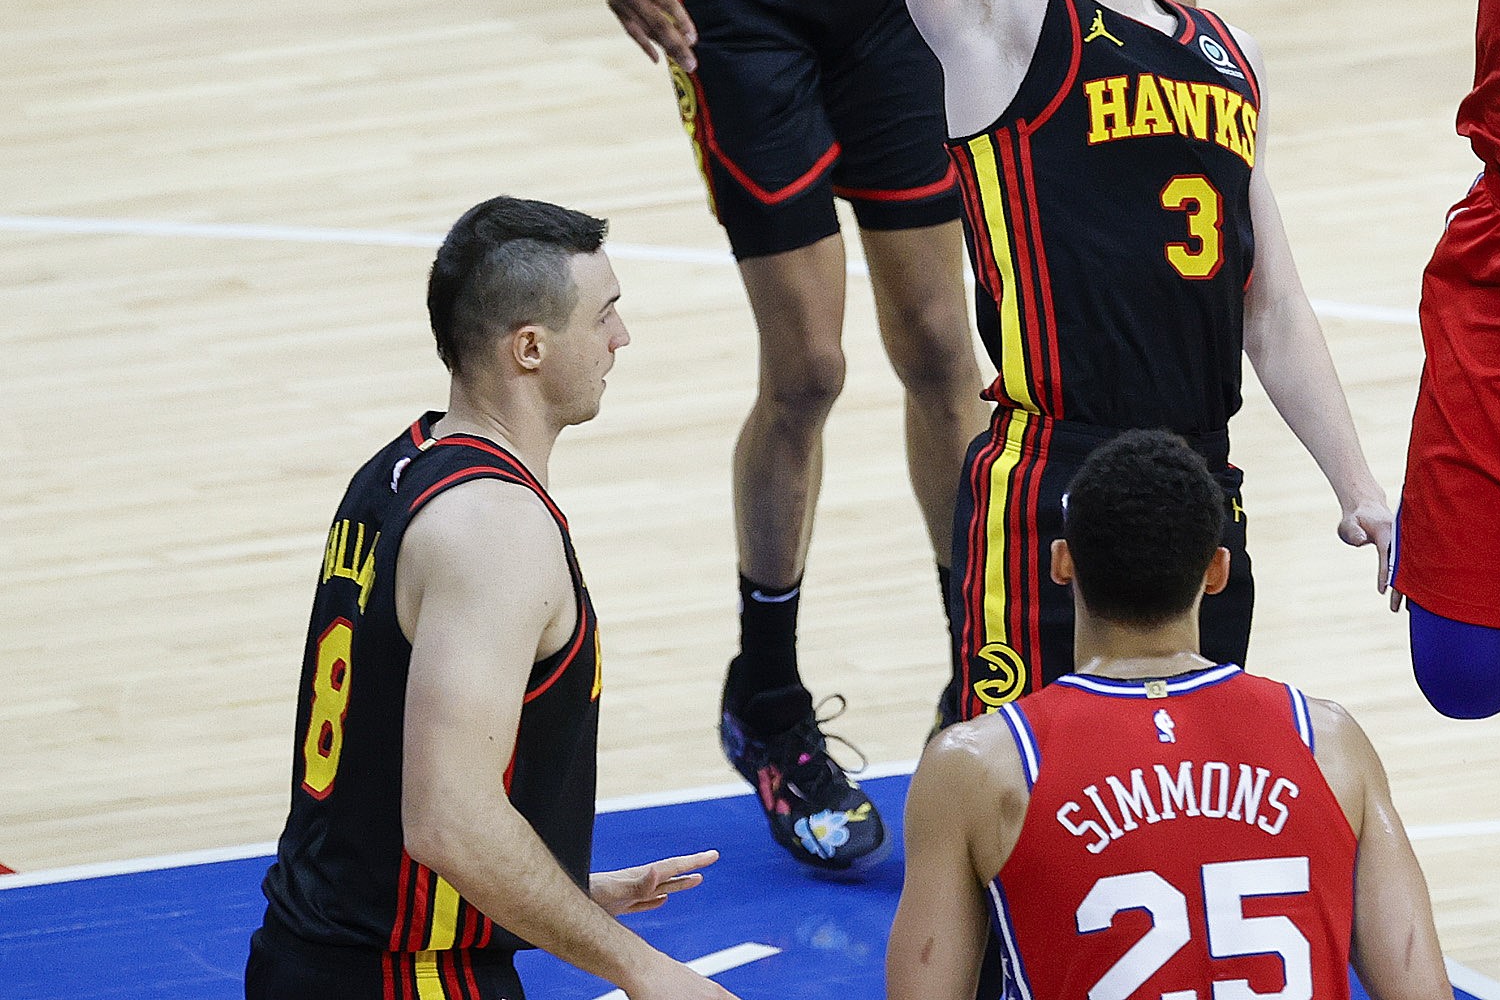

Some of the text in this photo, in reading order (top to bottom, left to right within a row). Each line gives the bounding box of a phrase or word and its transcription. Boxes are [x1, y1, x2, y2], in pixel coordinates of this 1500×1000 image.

[1083, 72, 1259, 169] HAWKS
[1159, 173, 1227, 281] 3
[300, 616, 355, 802] 8
[1055, 759, 1300, 855] SIMMONS
[1074, 855, 1315, 1000] 25
